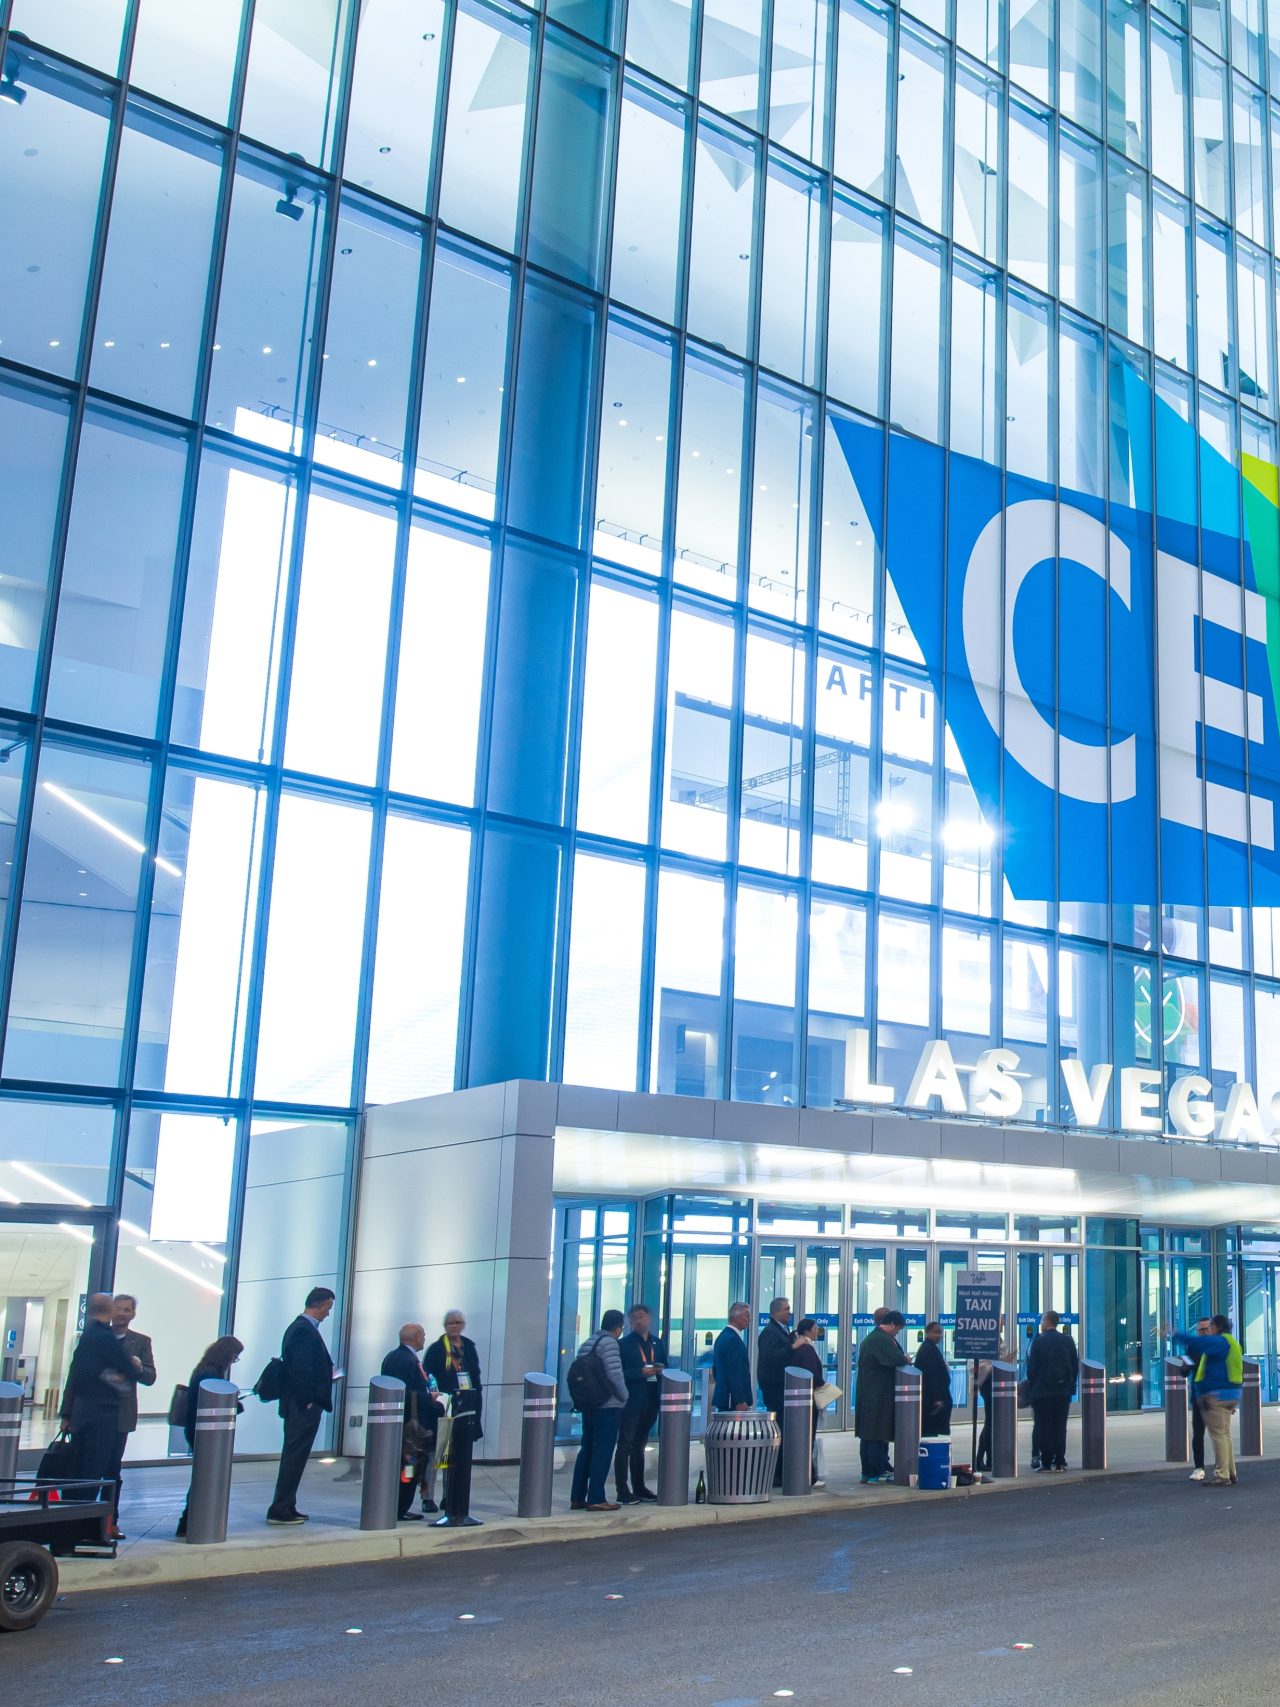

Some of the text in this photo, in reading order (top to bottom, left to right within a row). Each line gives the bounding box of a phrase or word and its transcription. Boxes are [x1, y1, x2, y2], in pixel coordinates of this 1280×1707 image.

[844, 1028, 1023, 1117] LAS
[965, 1299, 992, 1311] TAXI
[957, 1318, 997, 1331] STAND
